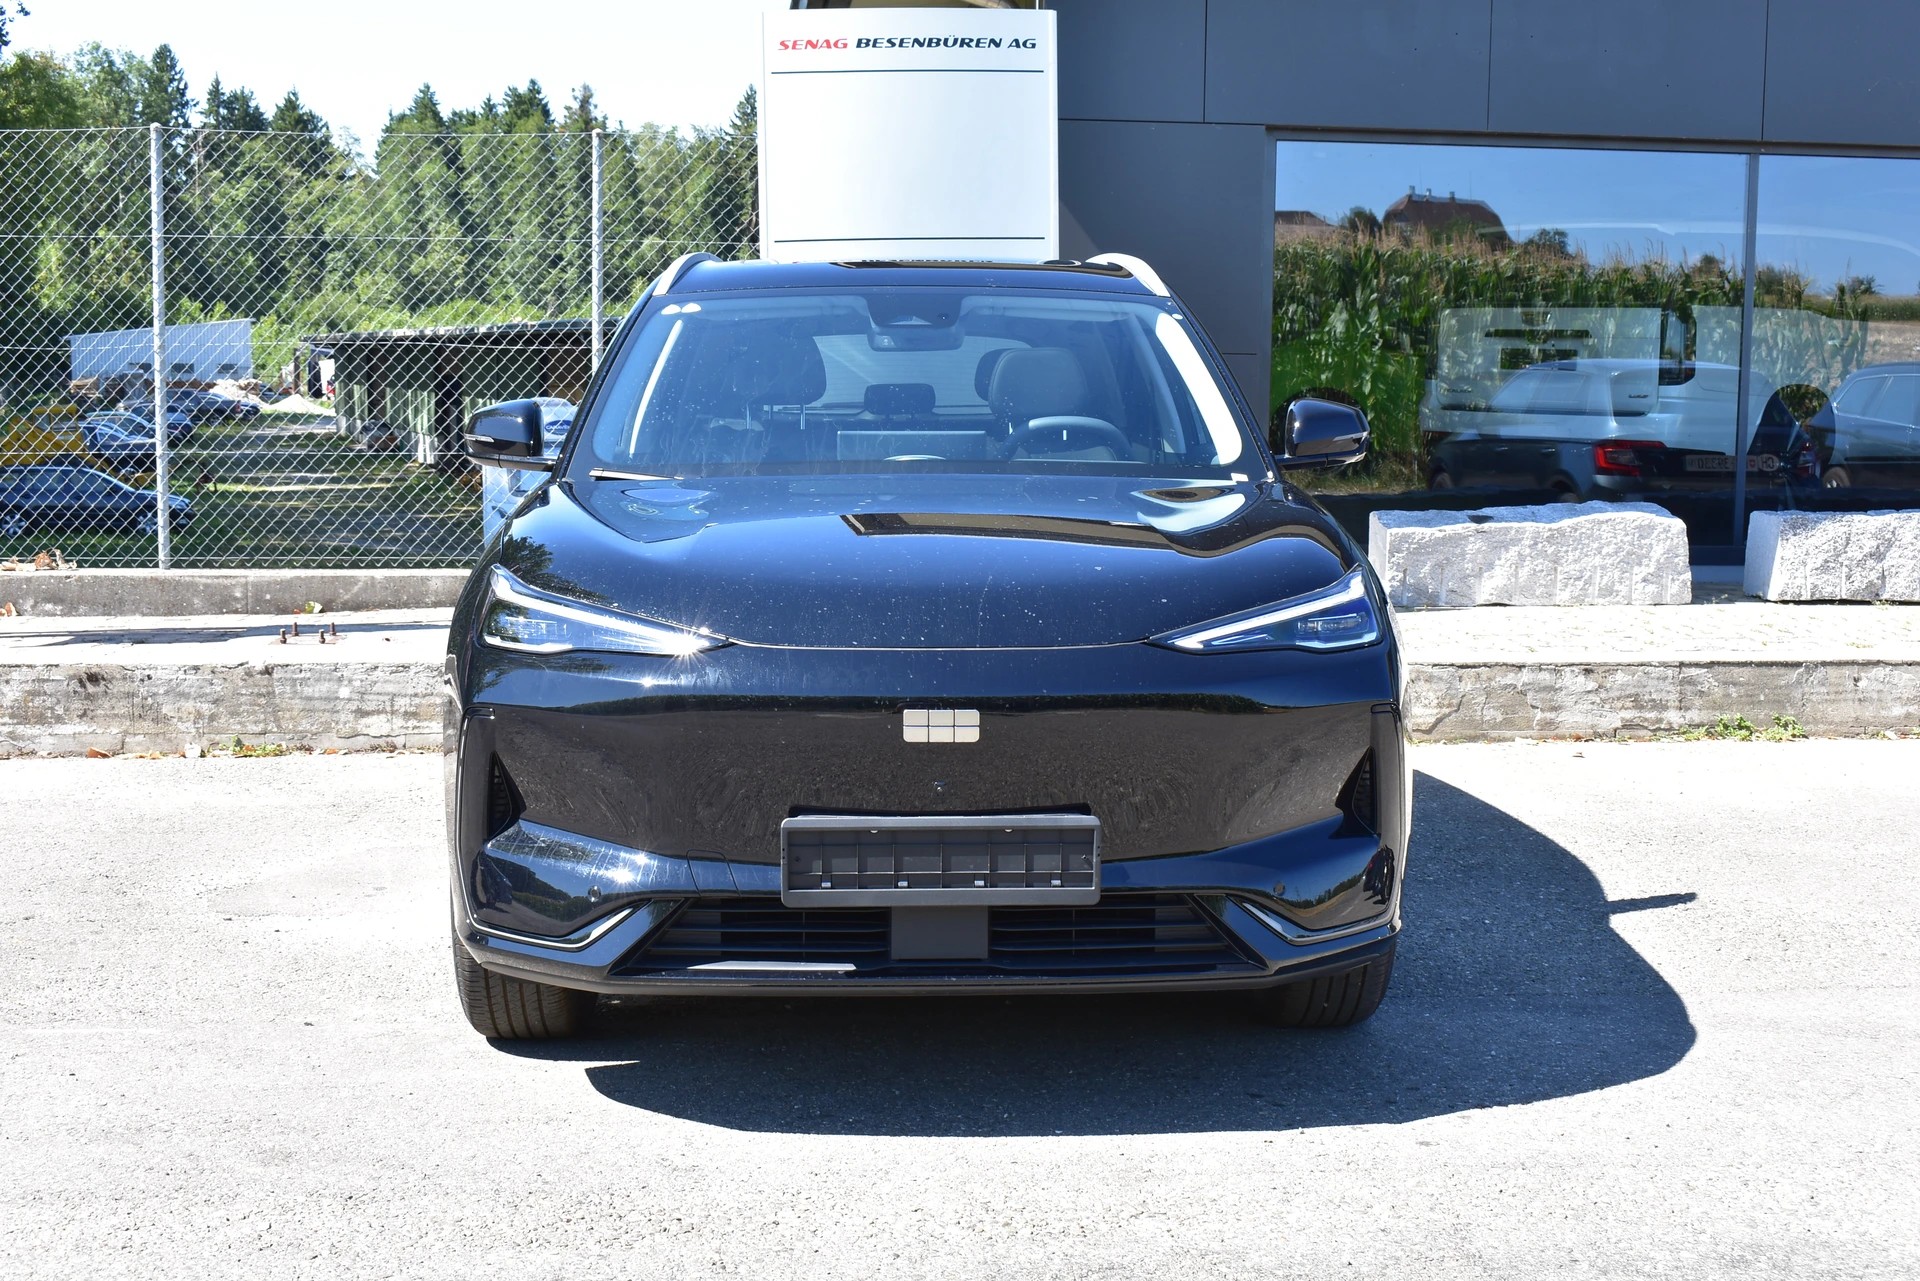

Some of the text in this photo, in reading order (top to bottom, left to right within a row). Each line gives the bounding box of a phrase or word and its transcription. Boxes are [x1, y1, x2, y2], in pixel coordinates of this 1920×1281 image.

[778, 34, 1037, 51] SENAG BESENBÜREN AG
